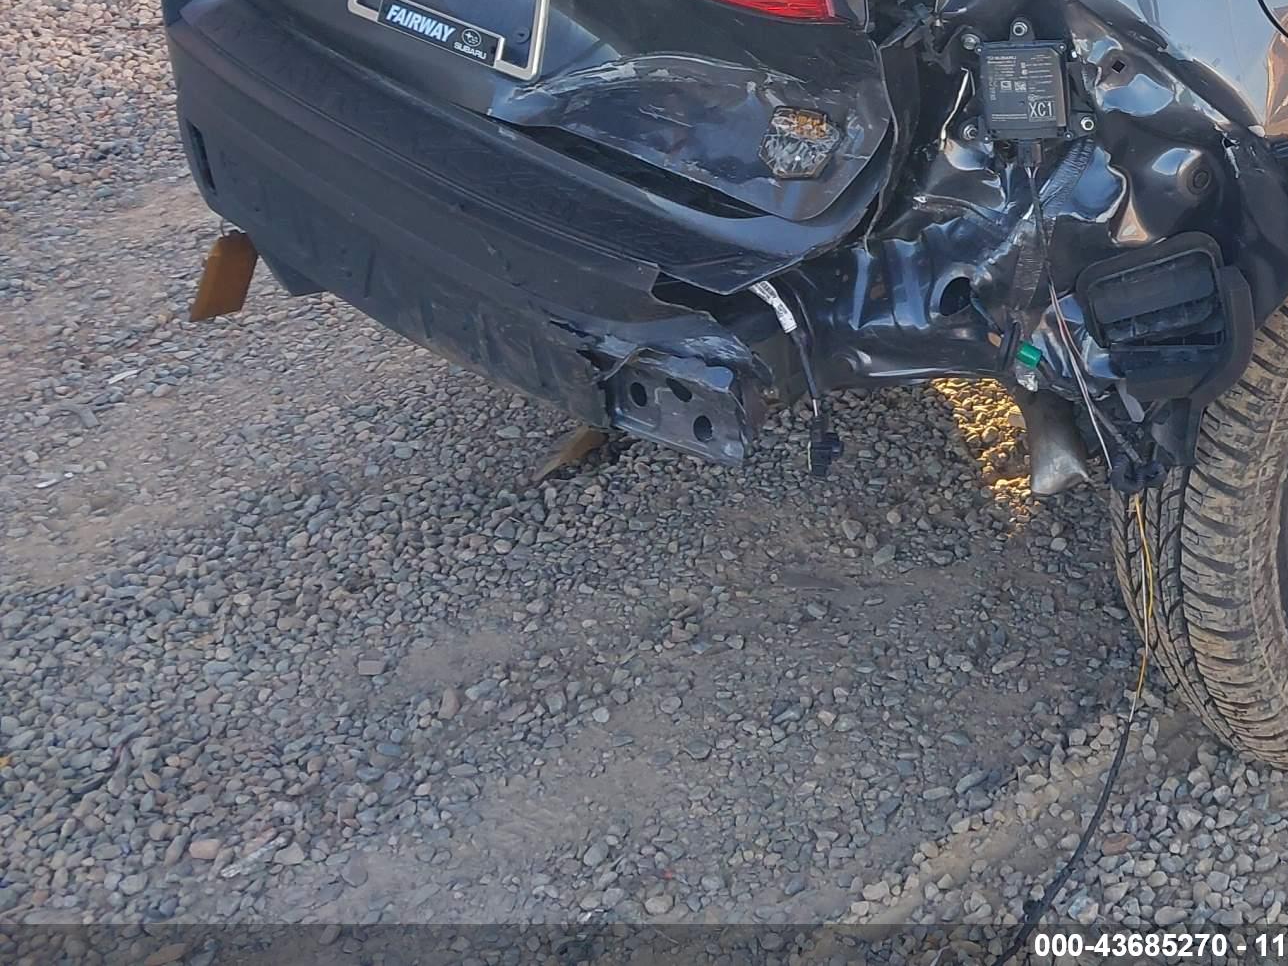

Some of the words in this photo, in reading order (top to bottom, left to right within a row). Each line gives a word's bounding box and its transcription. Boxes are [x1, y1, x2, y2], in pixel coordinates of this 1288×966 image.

[386, 4, 456, 42] FAIRWAY
[454, 42, 487, 59] SUBARU
[1028, 101, 1053, 117] XC1
